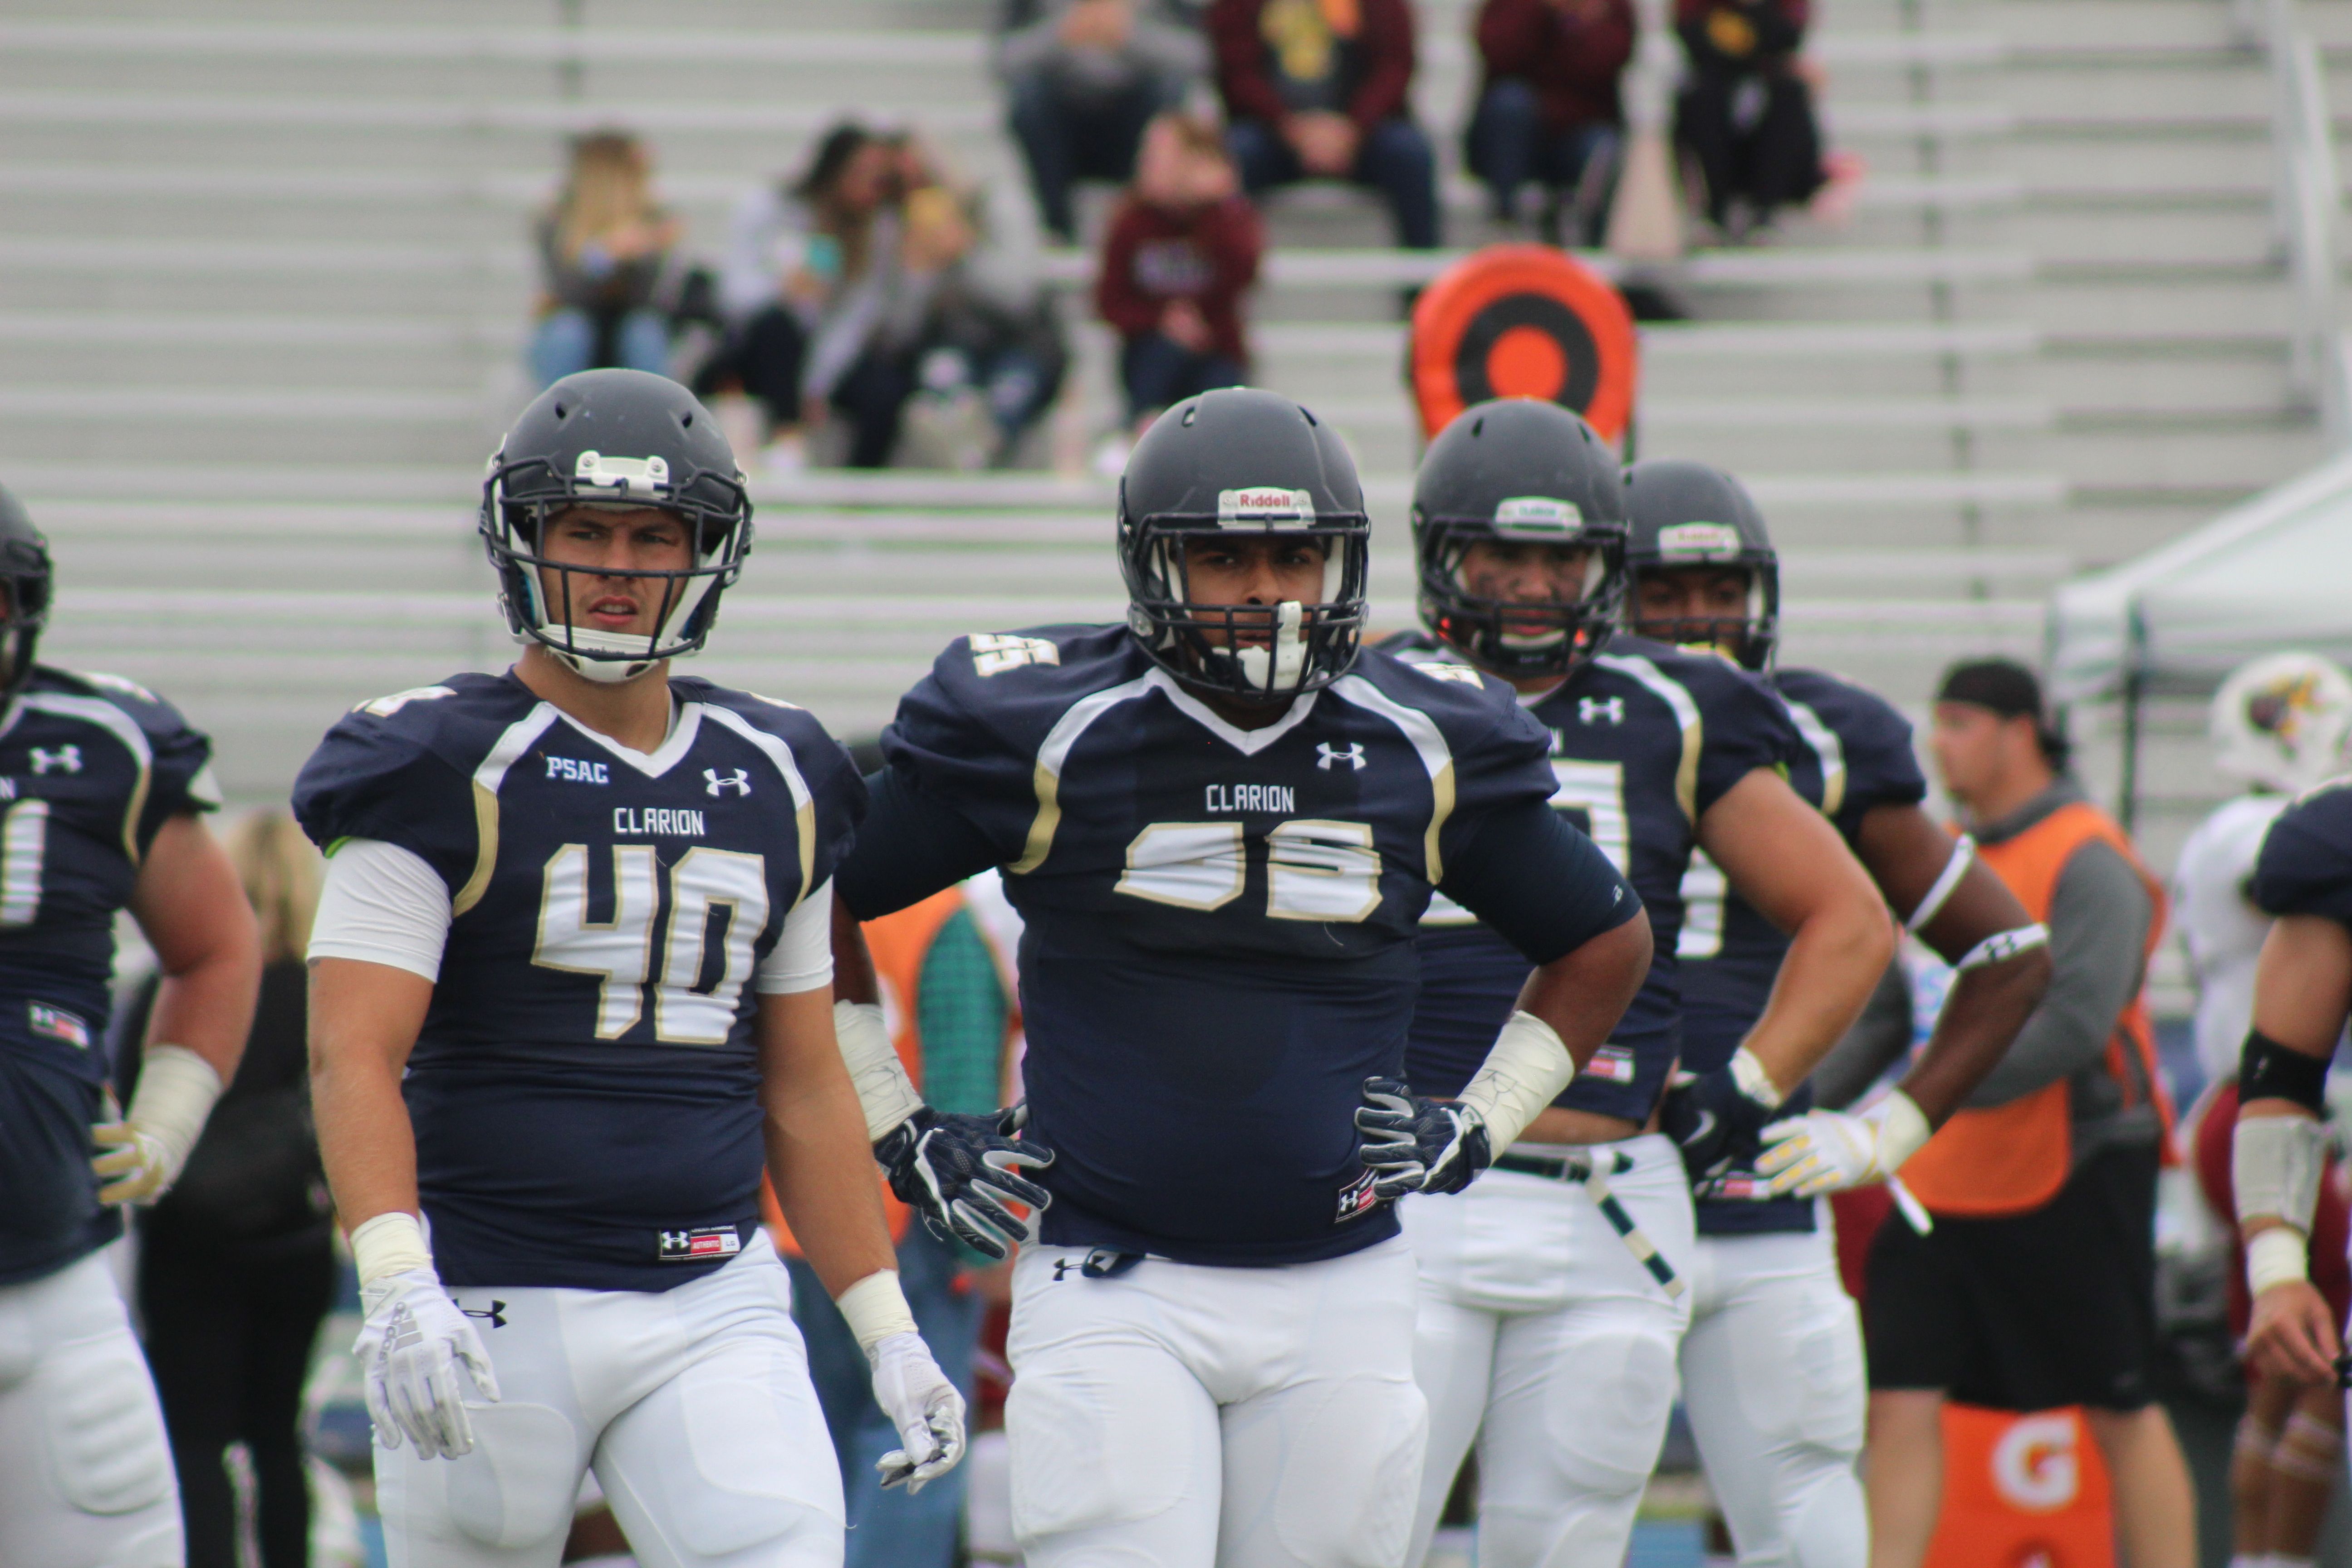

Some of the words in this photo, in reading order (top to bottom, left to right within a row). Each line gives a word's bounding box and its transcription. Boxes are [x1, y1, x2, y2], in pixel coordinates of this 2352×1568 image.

[1240, 494, 1290, 506] Riddell
[546, 756, 608, 784] PSAC
[1206, 784, 1294, 813] CLARION
[613, 808, 705, 835] CLARION
[530, 843, 769, 1044] 40
[693, 1240, 720, 1249] AUTHENTIC
[378, 1301, 406, 1361] adidas
[1991, 1411, 2081, 1514] G
